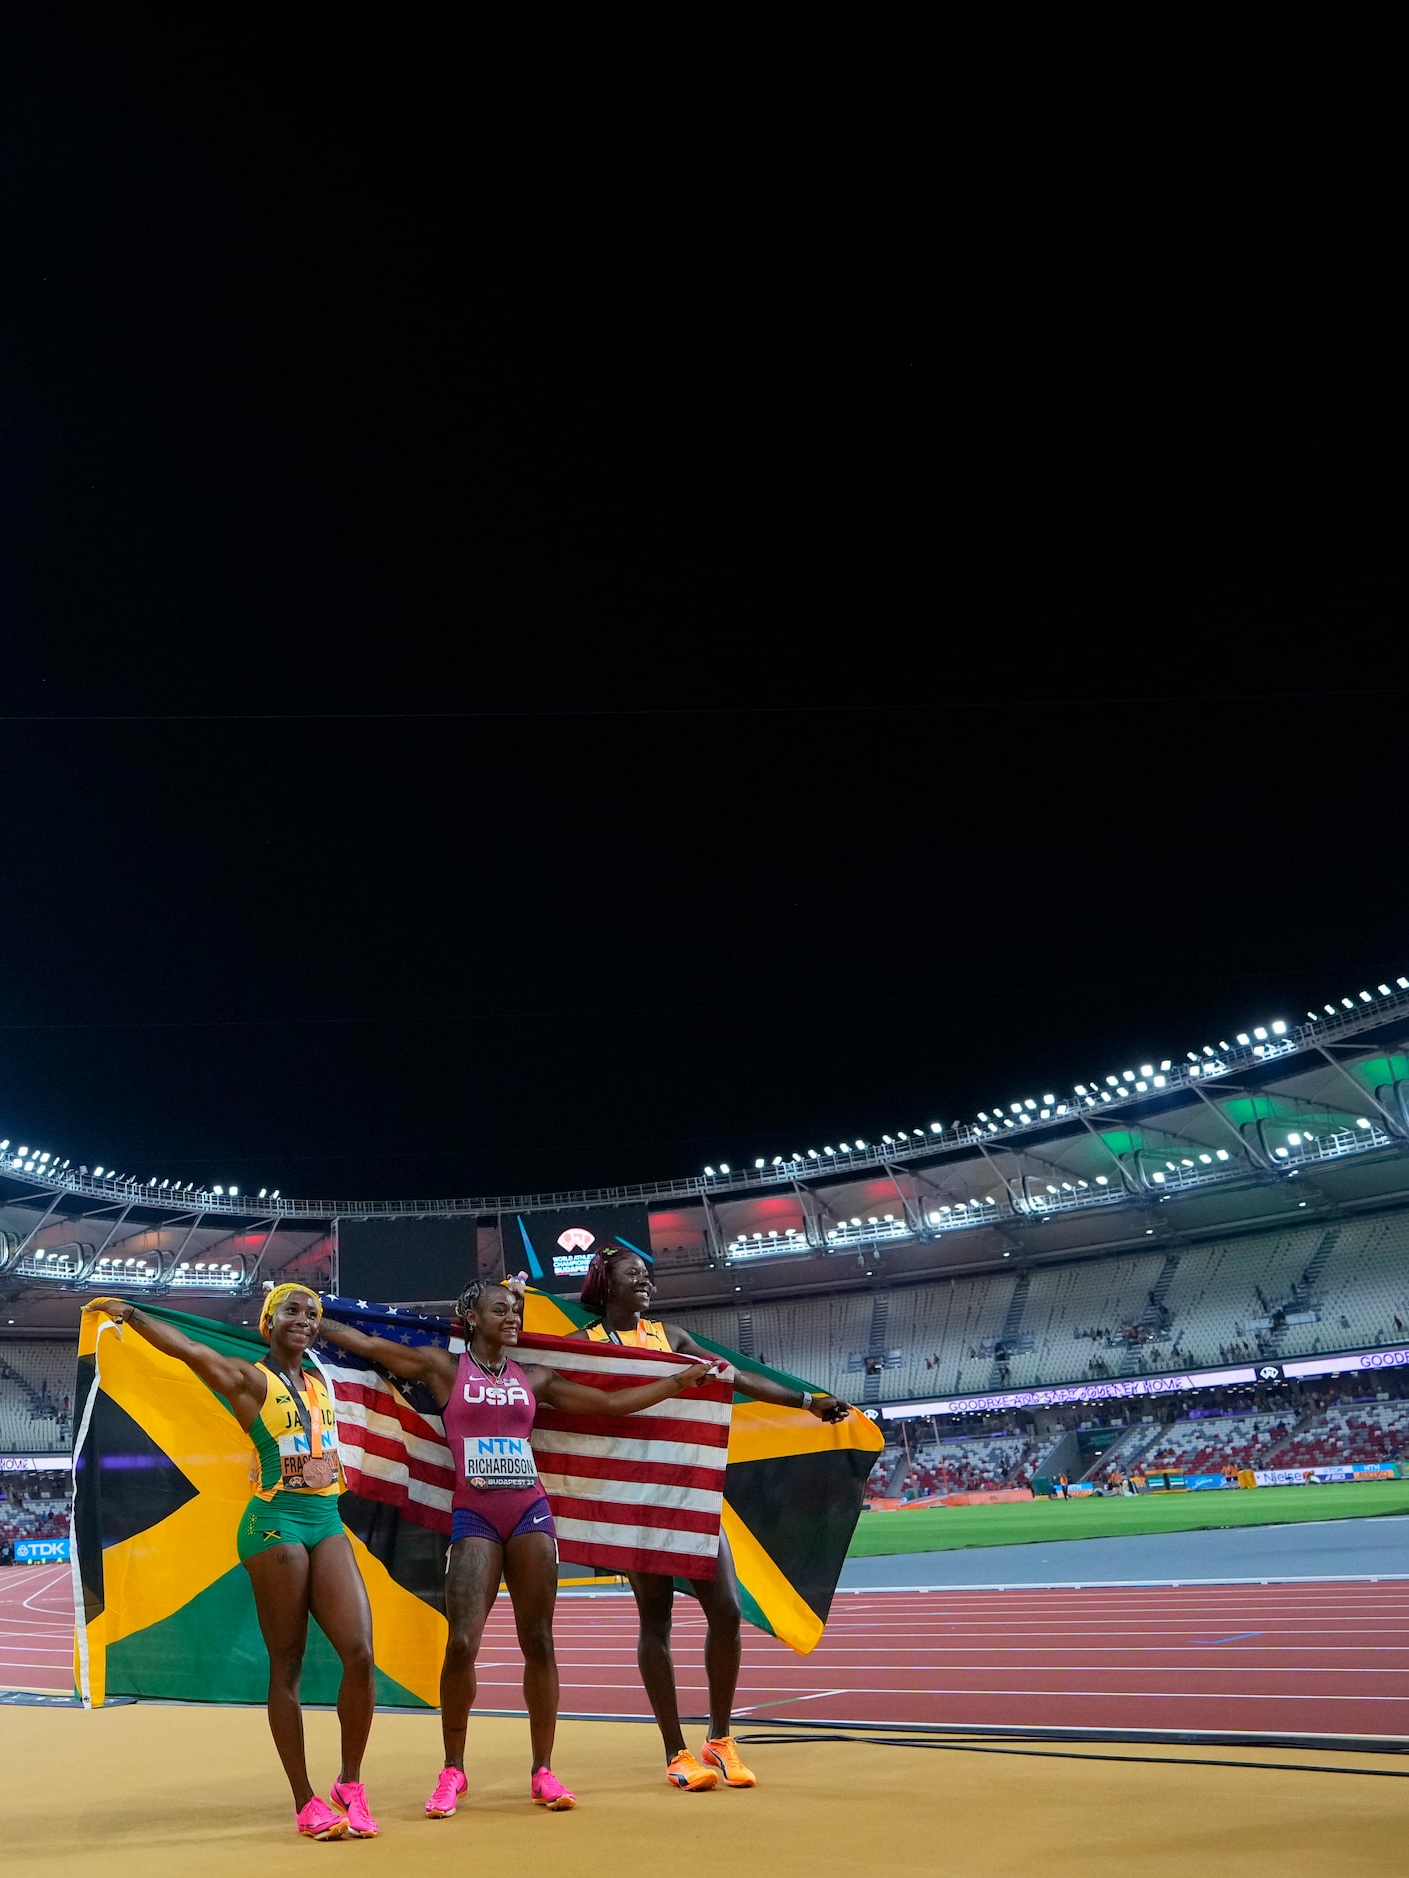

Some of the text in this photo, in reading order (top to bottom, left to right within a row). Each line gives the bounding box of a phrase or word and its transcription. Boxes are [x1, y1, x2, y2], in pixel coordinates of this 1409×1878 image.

[554, 1265, 589, 1274] BUDAPES
[463, 1384, 530, 1406] USA
[948, 1395, 1010, 1413] GOODBYE
[1143, 1377, 1183, 1394] HOME
[285, 1409, 335, 1429] JAIC
[293, 1431, 332, 1453] NN
[477, 1438, 523, 1455] NTN
[468, 1458, 534, 1474] RICHARDSON
[487, 1478, 526, 1486] BUDAPEST
[1263, 1472, 1303, 1484] Nielse
[27, 1543, 65, 1556] TDK
